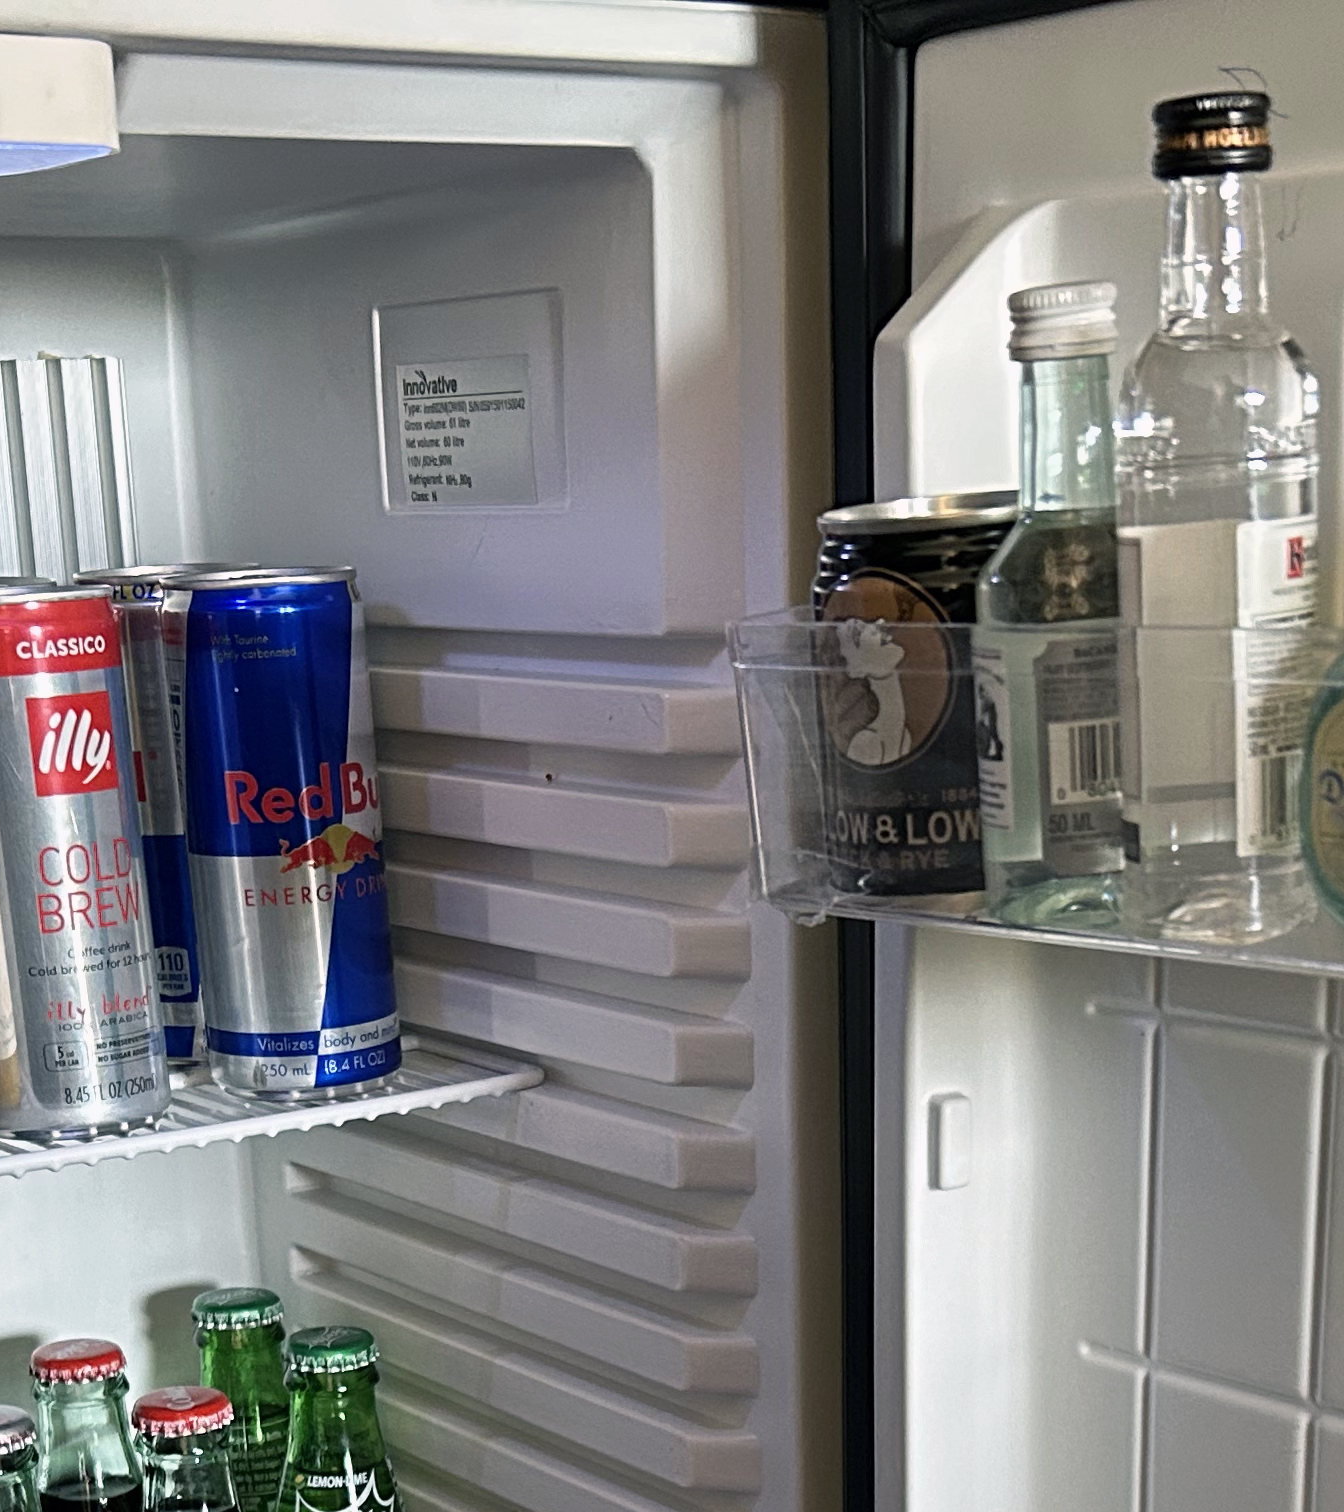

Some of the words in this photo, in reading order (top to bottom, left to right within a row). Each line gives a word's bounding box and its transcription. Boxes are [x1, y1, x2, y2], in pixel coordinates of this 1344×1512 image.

[15, 634, 106, 660] CLASSICO
[242, 646, 297, 660] carbonated
[37, 706, 113, 785] illy
[224, 762, 334, 825] Red
[340, 762, 379, 815] Bu
[875, 814, 899, 844] &
[906, 809, 981, 845] LOW
[1048, 813, 1068, 834] 50
[37, 837, 132, 888] COLD
[899, 849, 951, 870] RYE
[244, 883, 347, 907] ENERGY
[36, 885, 140, 935] BREW
[108, 941, 131, 954] drink
[28, 966, 57, 977] Cold
[107, 958, 121, 969] for
[123, 955, 132, 965] 12
[159, 953, 184, 971] 110
[47, 1001, 86, 1023] illy
[100, 1011, 148, 1028] ARABICA
[96, 1042, 107, 1050] NO
[257, 1036, 314, 1052] Vitalizes
[324, 1033, 356, 1050] body
[360, 1030, 379, 1043] and
[57, 1046, 64, 1059] 5
[98, 1055, 109, 1063] NO
[110, 1051, 131, 1061] SUGAR
[354, 1055, 365, 1070] FL
[64, 1086, 90, 1104] 8.45
[108, 1082, 122, 1099] OZ
